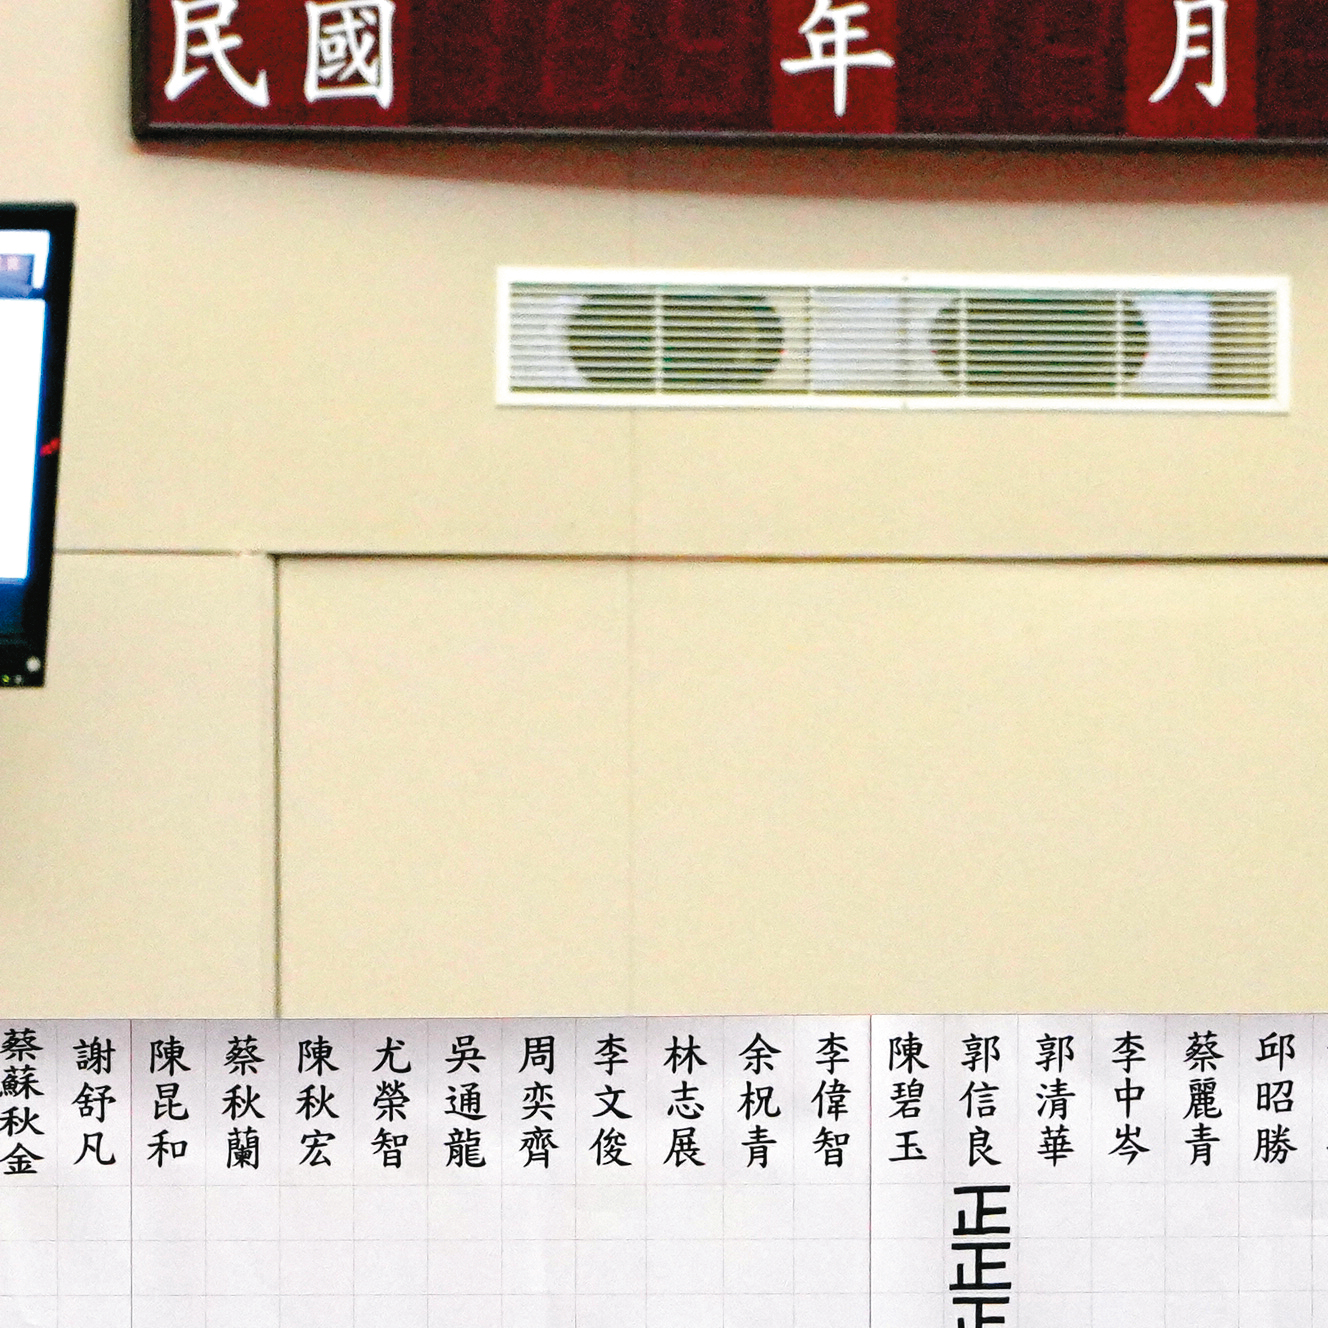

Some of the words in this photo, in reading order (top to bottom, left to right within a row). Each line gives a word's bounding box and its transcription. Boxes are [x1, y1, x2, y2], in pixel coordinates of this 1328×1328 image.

[165, 0, 395, 107] 民國
[781, 0, 894, 115] 年
[1150, 0, 1227, 106] 月
[0, 1028, 44, 1174] 蔡蘇秋金
[73, 1037, 116, 1165] 謝舒凡
[148, 1035, 190, 1167] 陳昆和
[223, 1035, 264, 1169] 蔡秋蘭
[297, 1035, 339, 1166] 陳秋宏
[373, 1037, 411, 1168] 尤榮智
[445, 1035, 486, 1167] 吳通龍
[520, 1036, 558, 1168] 周奕齊
[591, 1033, 631, 1166] 李文俊
[664, 1035, 706, 1166] 林志展
[812, 1032, 850, 1167] 李偉智
[889, 1032, 928, 1161] 陳碧玉
[960, 1034, 1000, 1166] 郭信良
[1036, 1033, 1075, 1165] 郭清華
[1111, 1031, 1149, 1164] 李中岑
[1184, 1031, 1222, 1166] 蔡麗青
[1255, 1032, 1297, 1164] 邱昭勝
